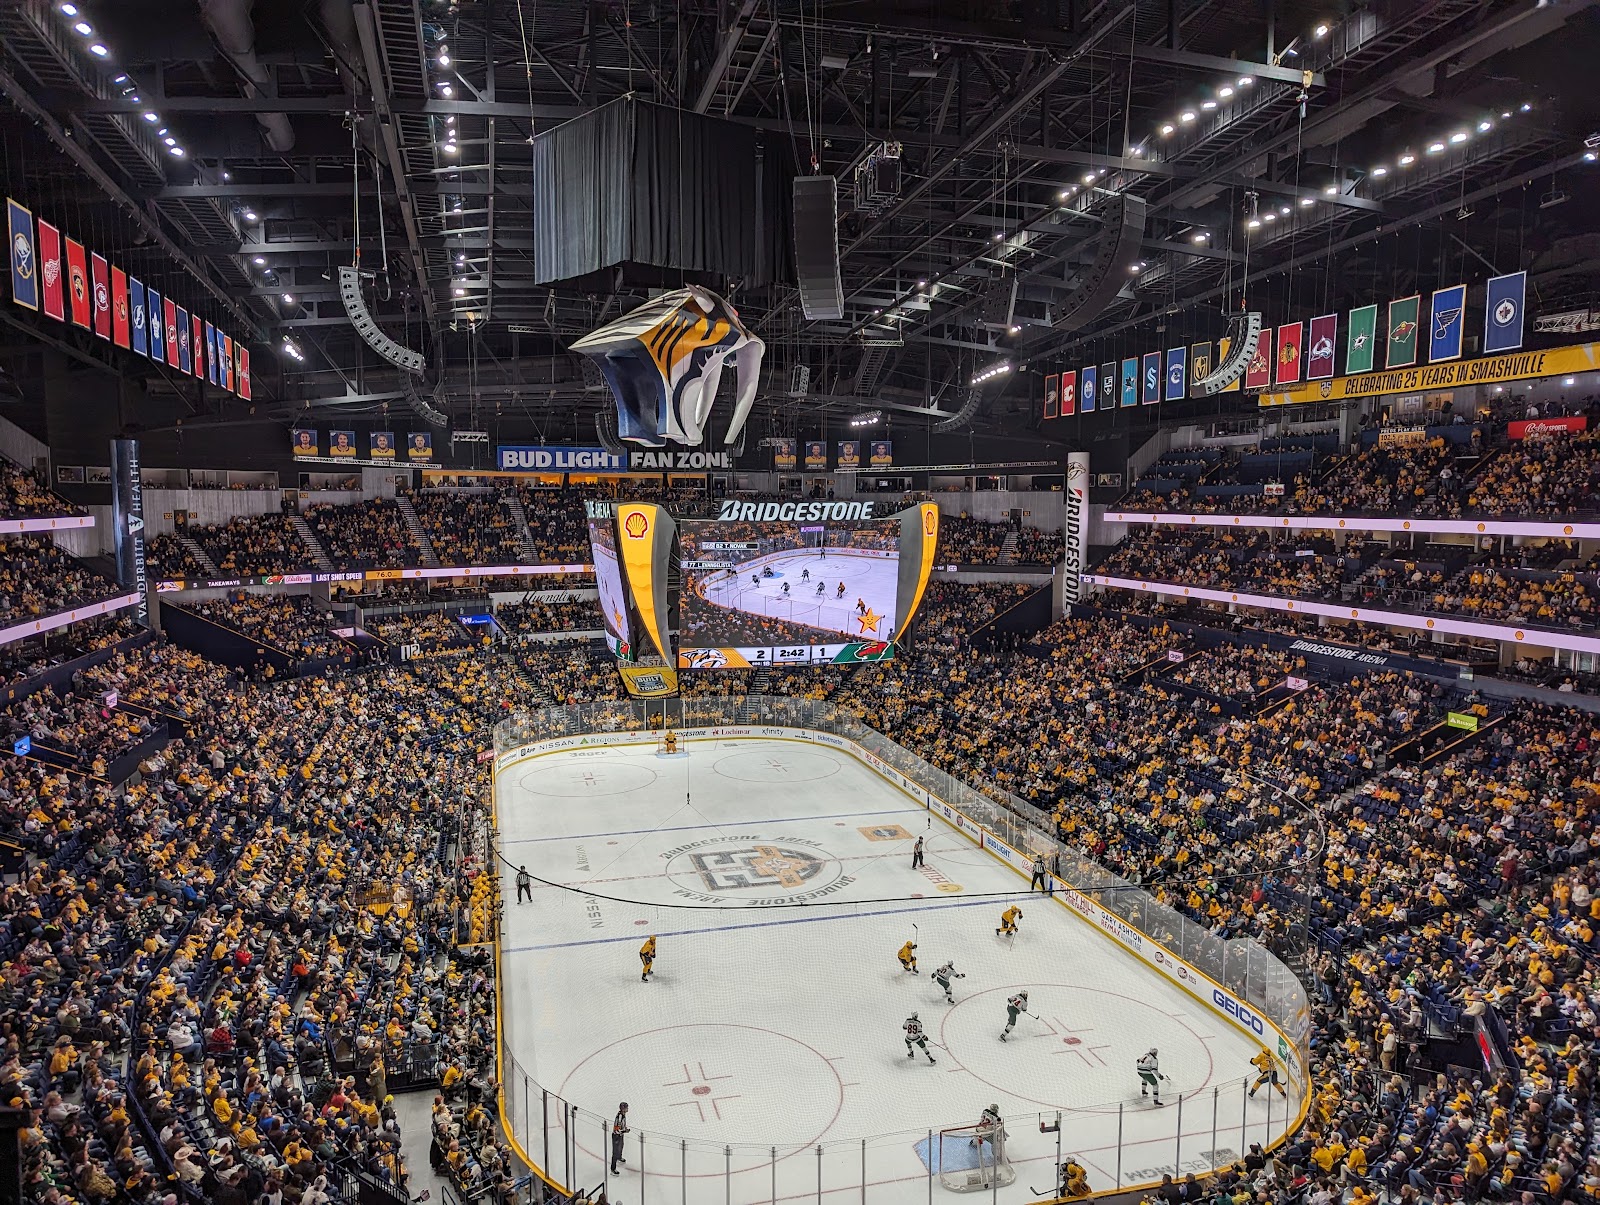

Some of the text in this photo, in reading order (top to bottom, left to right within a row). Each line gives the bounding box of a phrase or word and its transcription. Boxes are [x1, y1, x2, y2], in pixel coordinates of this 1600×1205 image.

[1345, 354, 1546, 394] CELEBRATING 25 YEARS IN SMASHVILLE
[502, 451, 733, 468] BUD LIGHT FAN ZONE
[130, 459, 141, 511] HEALTH
[718, 500, 874, 521] BRIDGESTONE
[135, 537, 148, 618] VANDERBILT
[316, 572, 362, 582] LAST SHOT SPEED
[756, 647, 826, 659] 2 2:42 1
[1289, 640, 1388, 665] BRIDGESTONE ARENA
[761, 728, 784, 737] xfinity
[817, 735, 844, 746] ticketmaster
[539, 739, 574, 750] NISSAN
[659, 835, 761, 860] BRIDGESTONE
[987, 837, 1011, 858] BUD LIGHT
[671, 876, 857, 908] BRIDGESTONE ARENA
[584, 893, 604, 929] NISSAN
[1079, 895, 1096, 915] HILL
[1101, 911, 1142, 945] GARY ASHTON
[1213, 989, 1264, 1036] GEICO
[907, 1024, 918, 1035] 89
